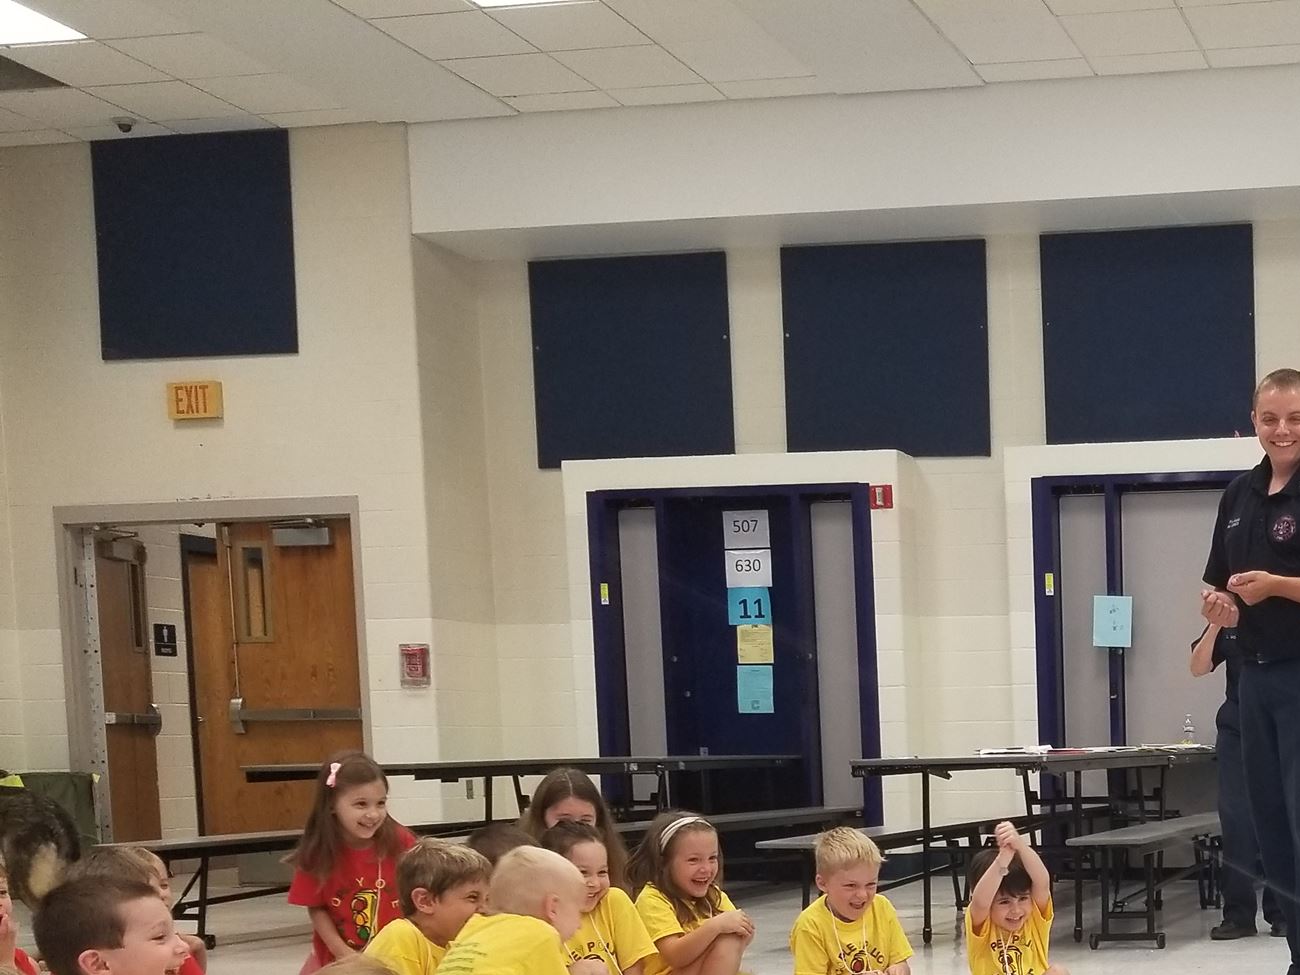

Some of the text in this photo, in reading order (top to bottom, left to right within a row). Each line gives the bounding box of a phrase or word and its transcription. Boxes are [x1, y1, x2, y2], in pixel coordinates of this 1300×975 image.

[174, 384, 211, 415] EXIT
[732, 519, 759, 534] 507
[734, 558, 762, 573] 630
[738, 598, 766, 619] 11
